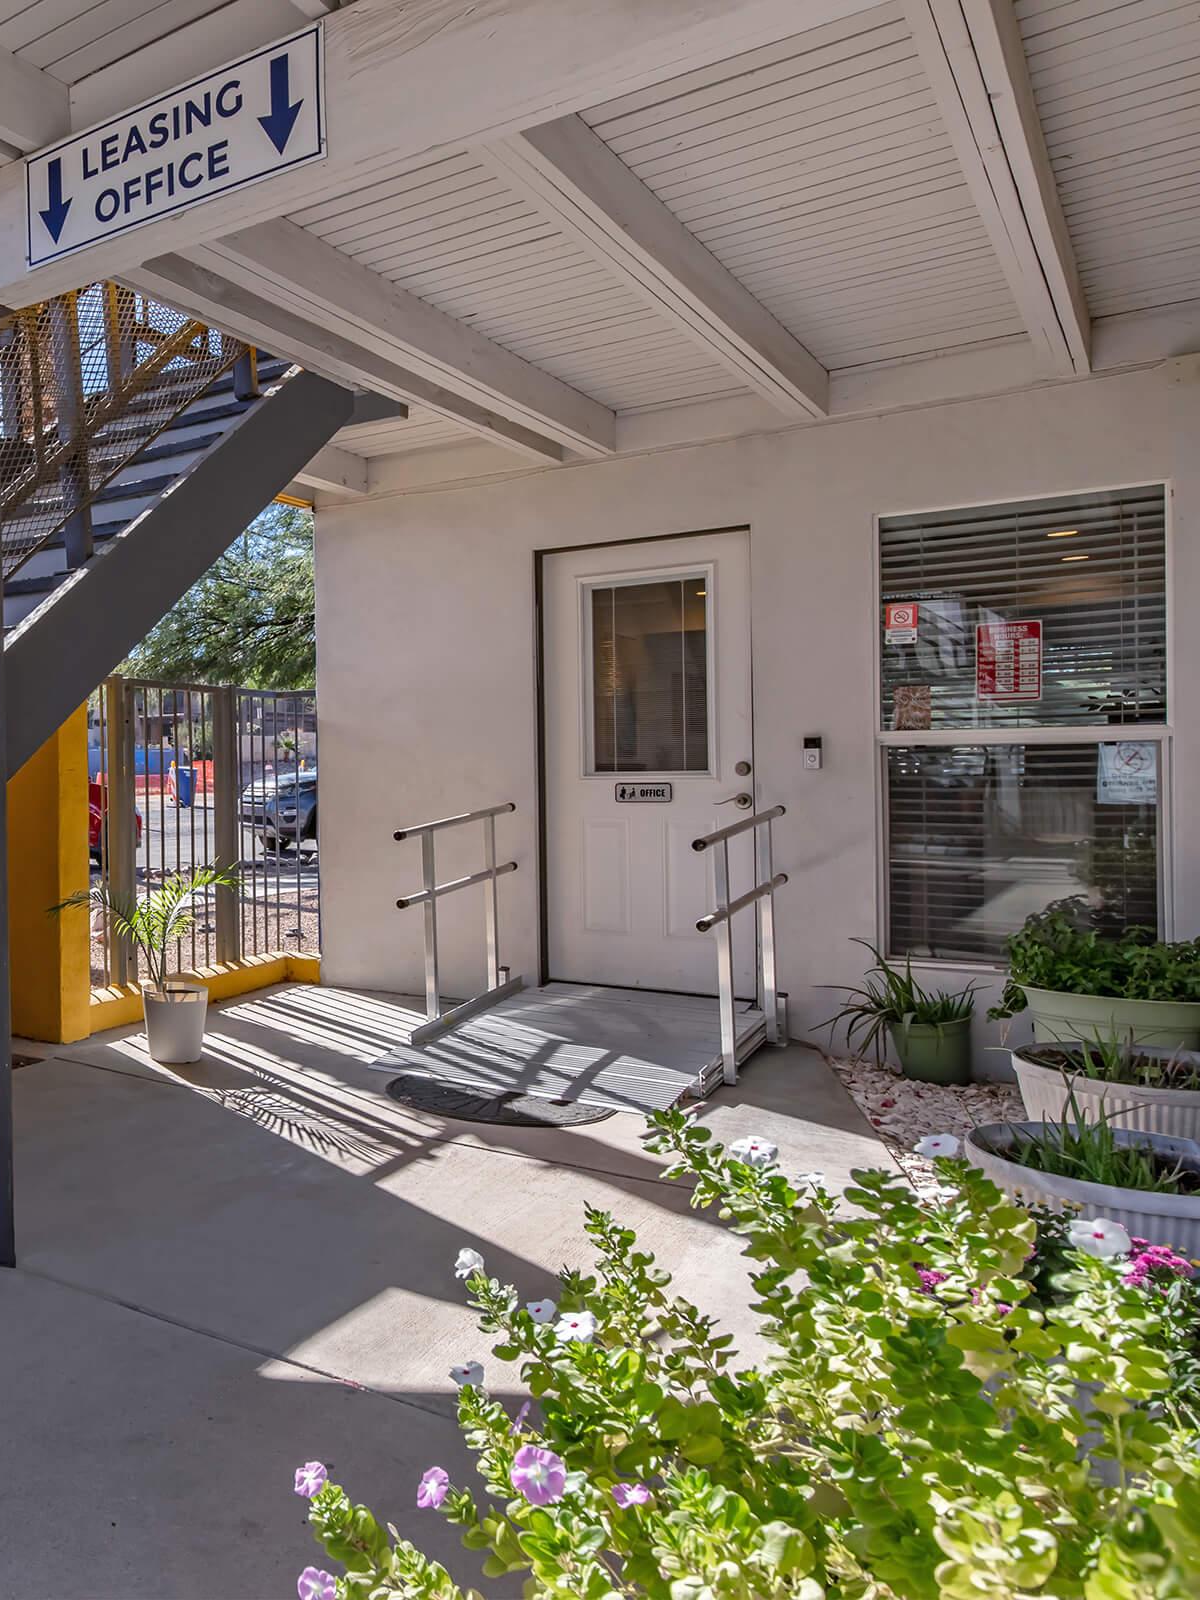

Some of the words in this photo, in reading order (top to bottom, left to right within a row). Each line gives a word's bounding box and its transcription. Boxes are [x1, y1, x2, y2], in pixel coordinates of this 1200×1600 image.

[82, 80, 243, 180] LEASING
[94, 139, 230, 223] OFFICE
[640, 789, 666, 797] OFFICE
